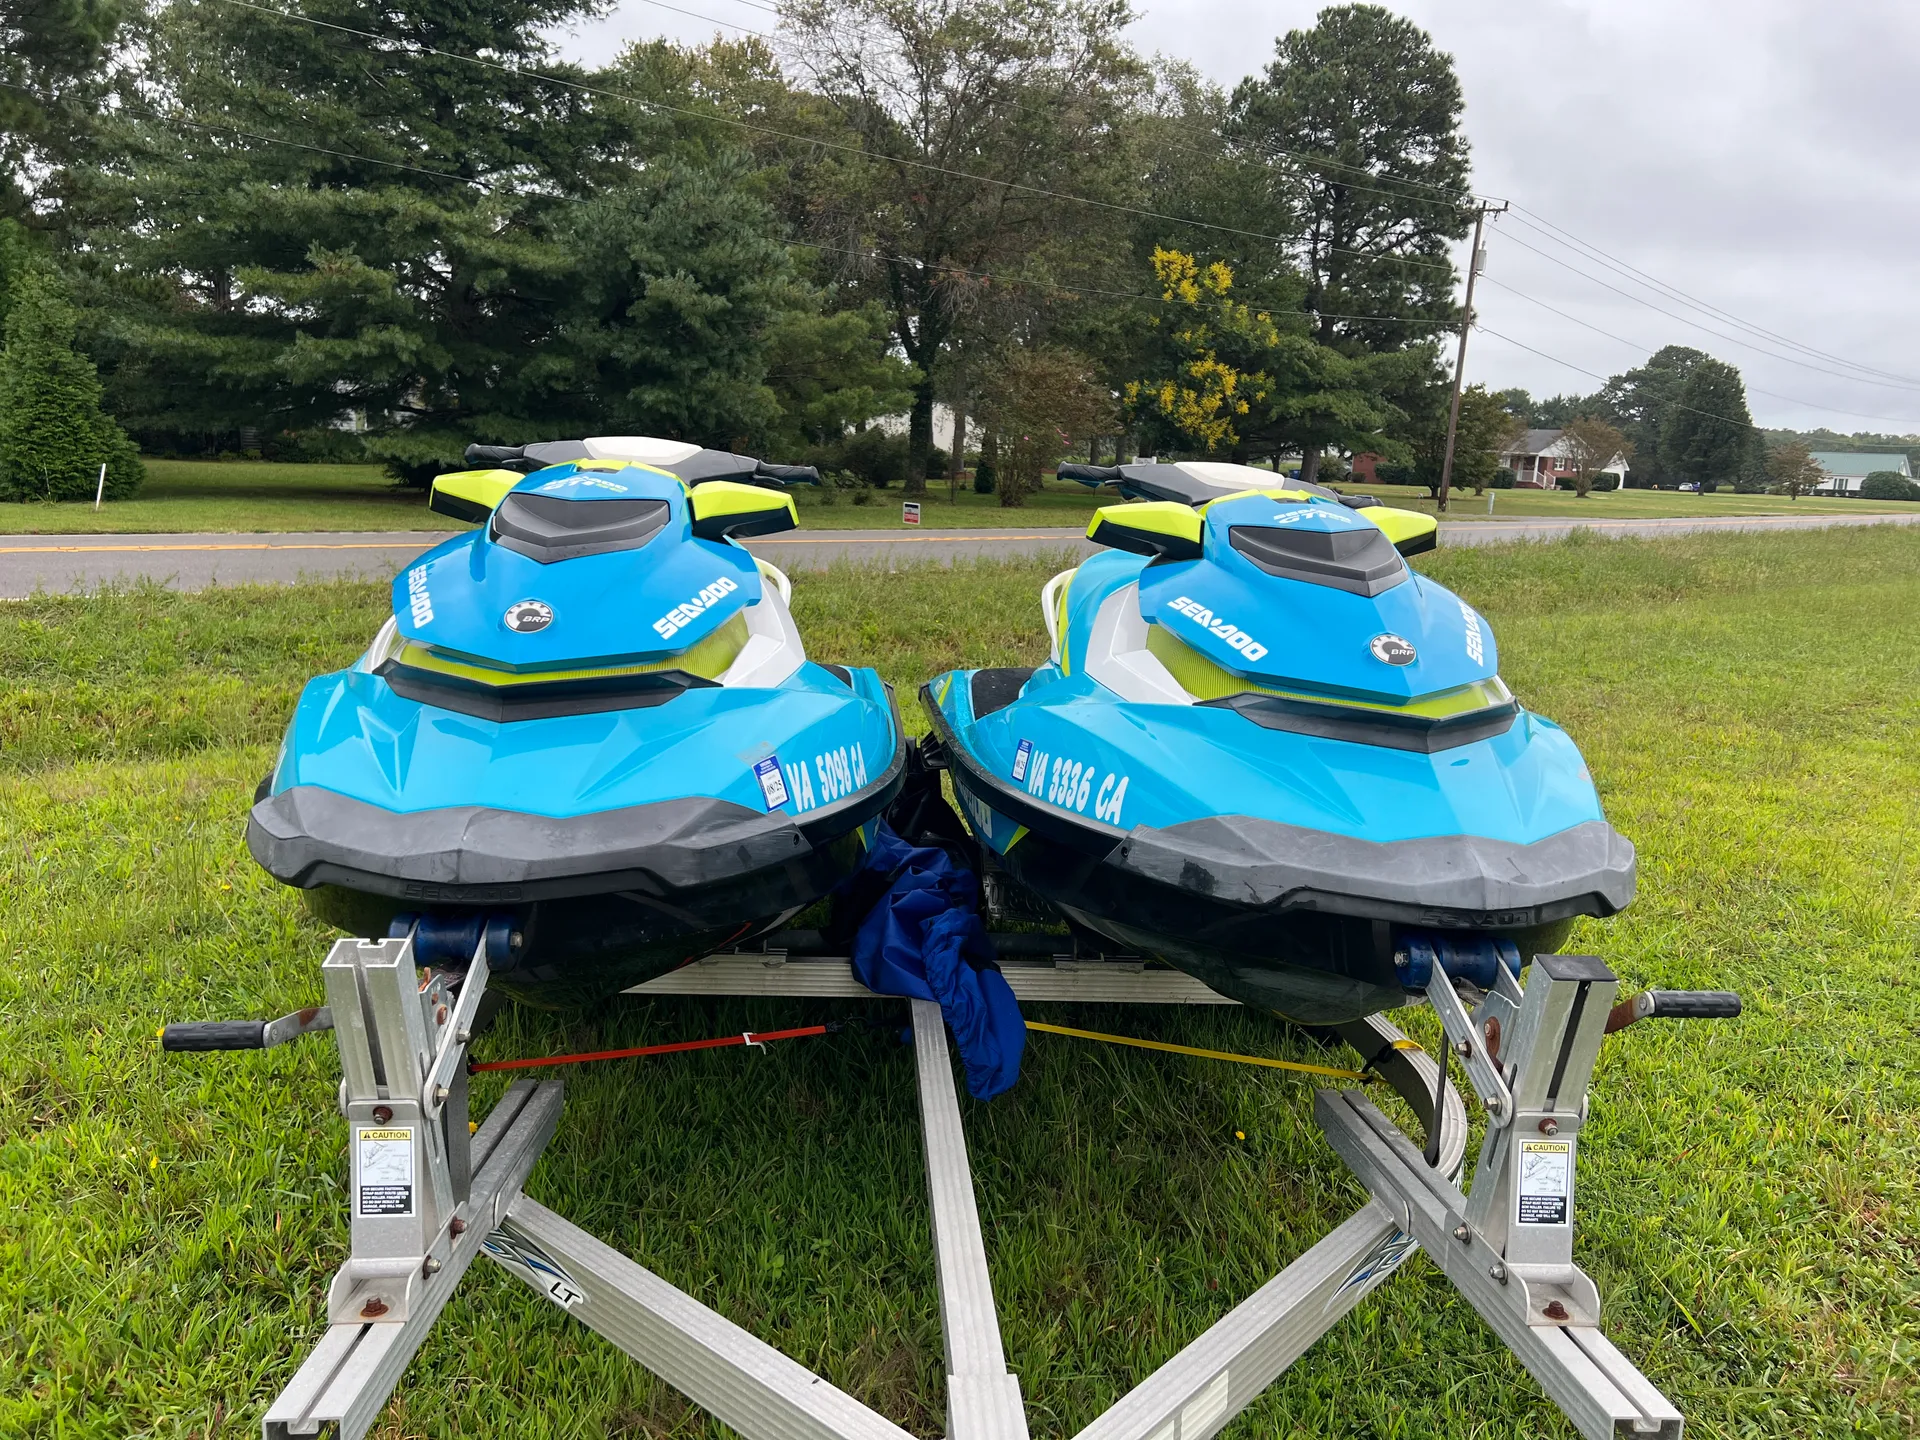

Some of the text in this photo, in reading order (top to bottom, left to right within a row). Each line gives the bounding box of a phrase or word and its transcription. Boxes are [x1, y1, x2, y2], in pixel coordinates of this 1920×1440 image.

[522, 615, 551, 623] BRP
[1391, 648, 1415, 656] BRP
[786, 741, 867, 813] VA 5098 CA
[1028, 750, 1129, 825] VA 3336 CA
[549, 1281, 580, 1304] LT
